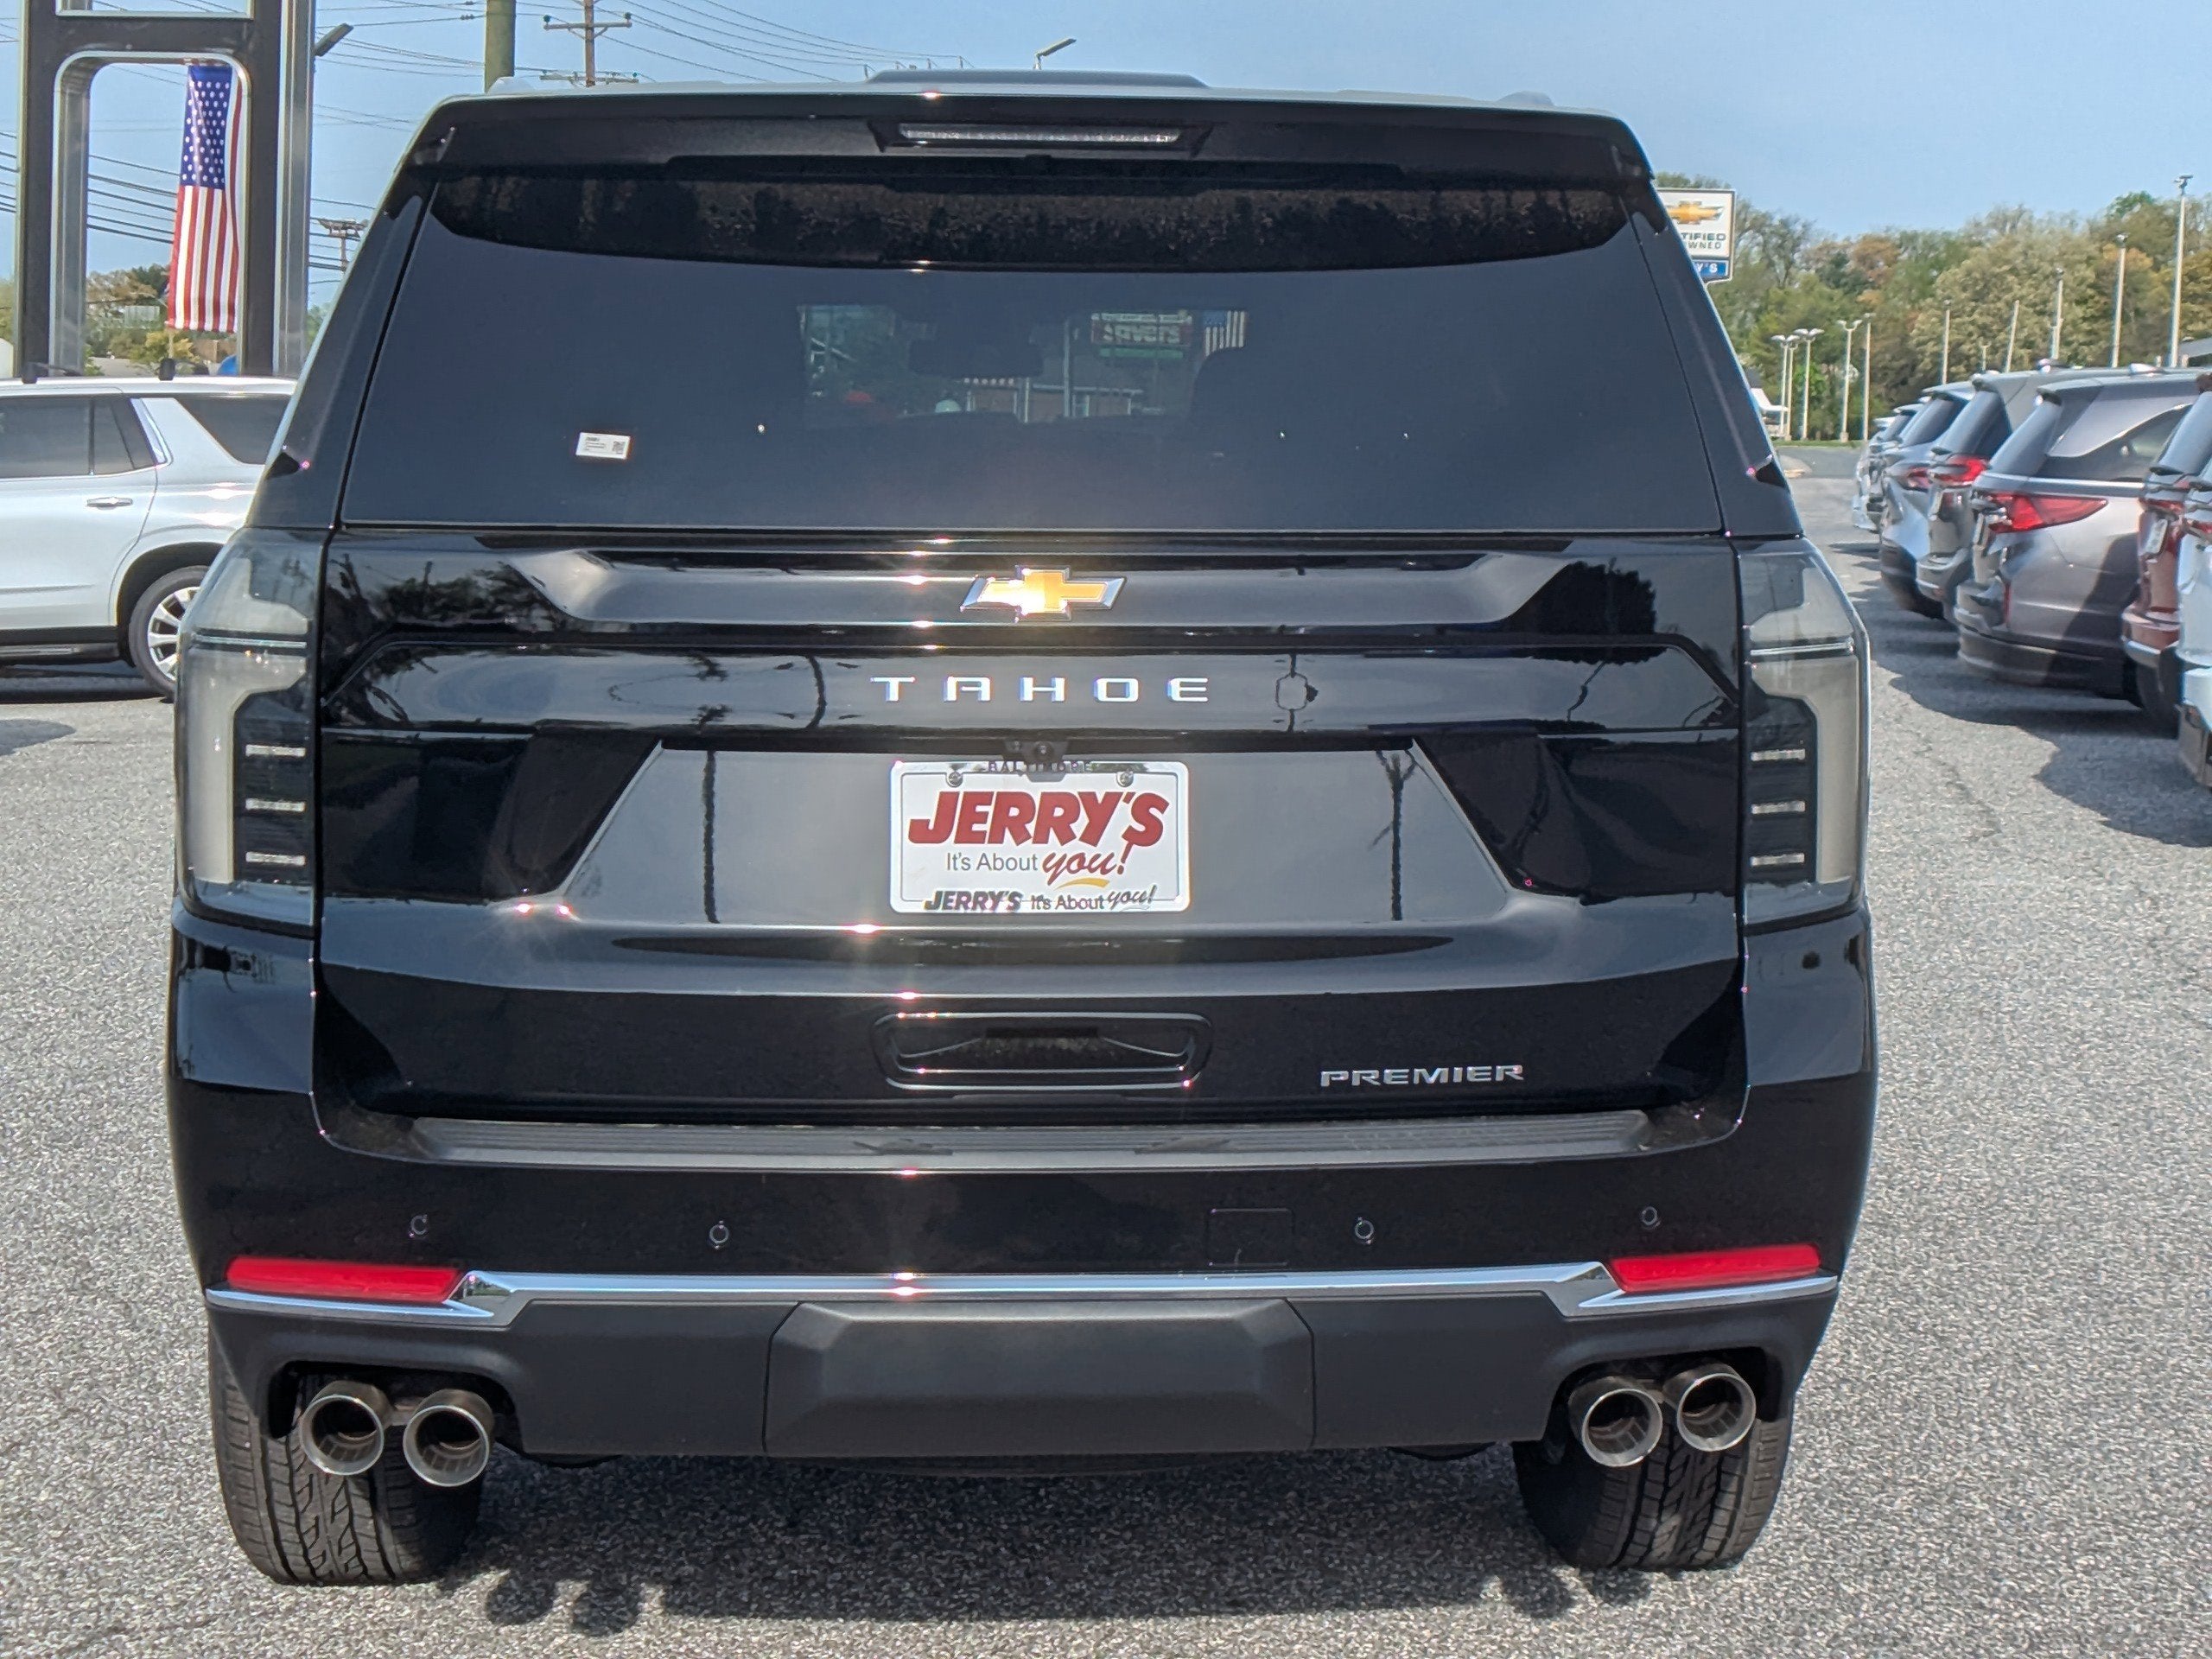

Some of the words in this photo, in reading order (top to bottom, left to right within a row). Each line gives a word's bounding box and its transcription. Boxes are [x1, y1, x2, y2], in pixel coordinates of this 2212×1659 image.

[1681, 232, 1726, 241] TIFIED
[870, 677, 1209, 702] TAHOE
[908, 791, 1169, 847] JERRY'S
[947, 852, 971, 871] It's
[976, 852, 1038, 871] About
[1042, 842, 1134, 887] you!
[924, 890, 1023, 911] JERRY'S
[1031, 894, 1052, 910] It's
[1056, 894, 1105, 910] About
[1107, 885, 1157, 906] you!
[1320, 1065, 1524, 1087] PREMIER
